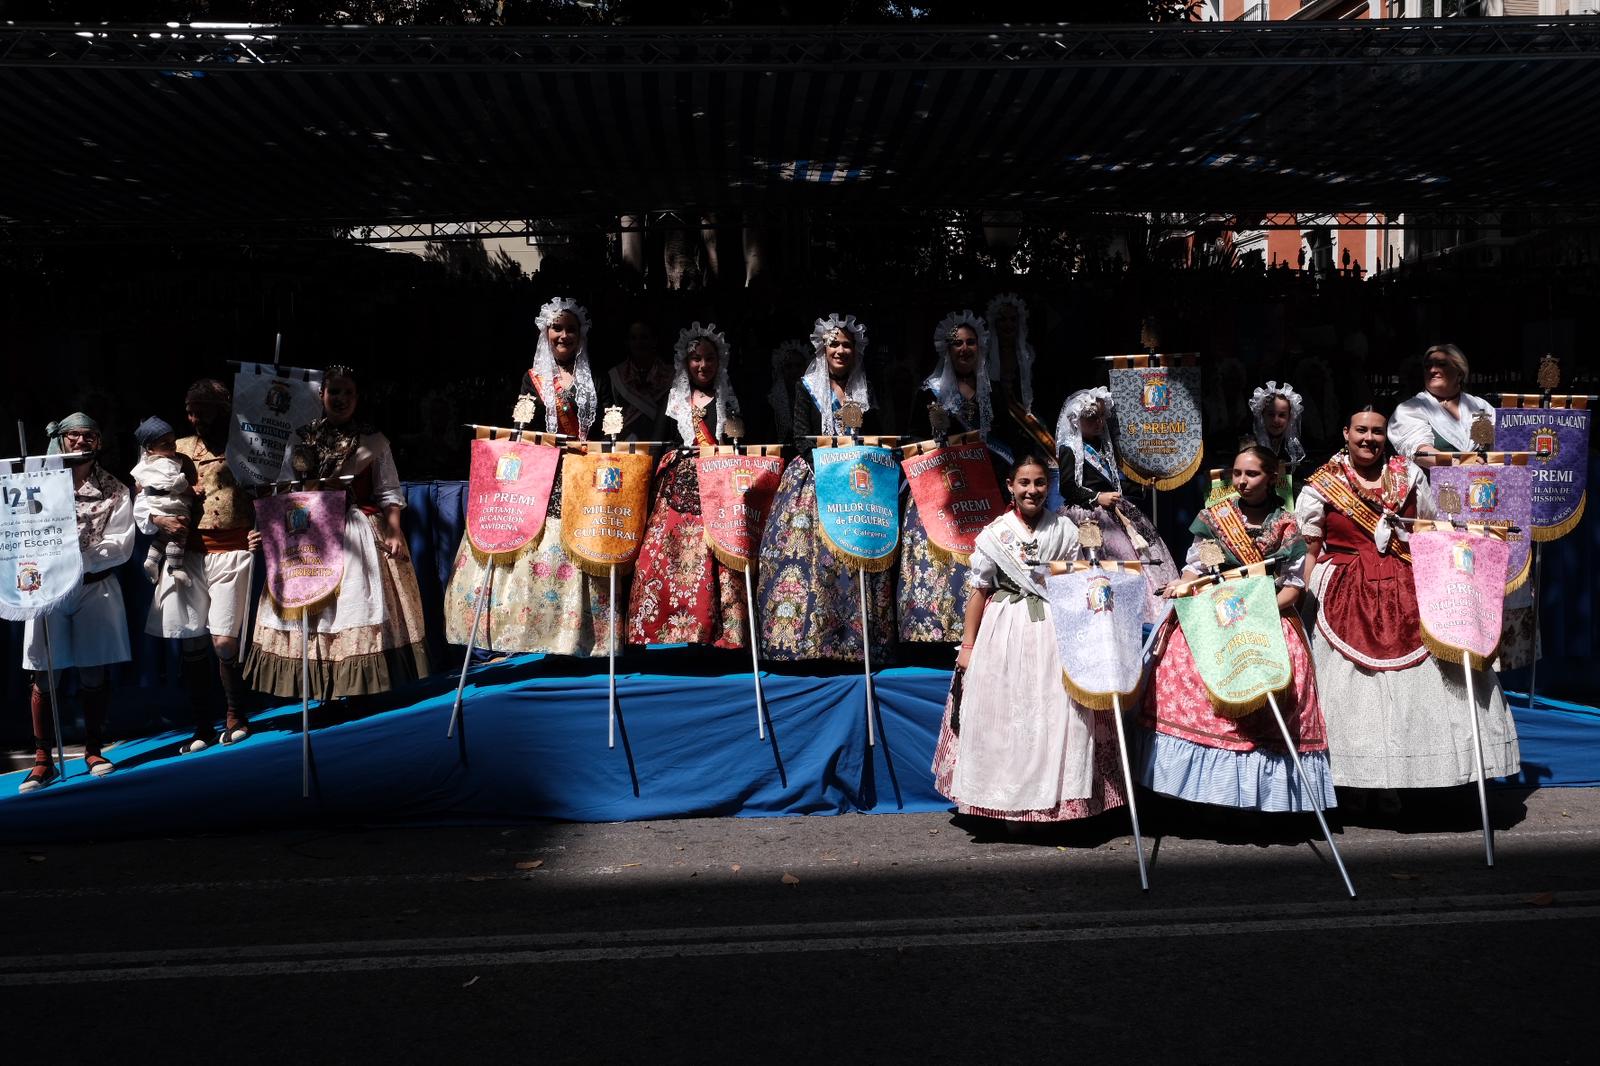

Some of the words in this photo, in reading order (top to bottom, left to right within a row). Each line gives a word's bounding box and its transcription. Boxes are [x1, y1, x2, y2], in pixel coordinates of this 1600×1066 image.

[1143, 421, 1187, 434] PREMI
[1500, 415, 1545, 429] AJUNTAMENT
[702, 459, 742, 473] AJUNTAMENT
[820, 452, 860, 466] AJUNTAMENT
[493, 492, 536, 506] PREMI
[583, 505, 632, 516] MILLOR
[718, 508, 725, 518] 3
[733, 504, 761, 521] PREMI
[827, 502, 864, 513] MILLOR
[937, 509, 945, 520] 5
[951, 499, 992, 515] PREMI
[592, 516, 624, 528] ACTE
[836, 516, 846, 525] de
[848, 514, 891, 528] FOGUERES
[946, 514, 989, 529] FOGUERES
[5, 528, 41, 539] Premio
[53, 526, 63, 535] la
[574, 528, 639, 540] CULTURAL
[24, 537, 63, 548] Escena
